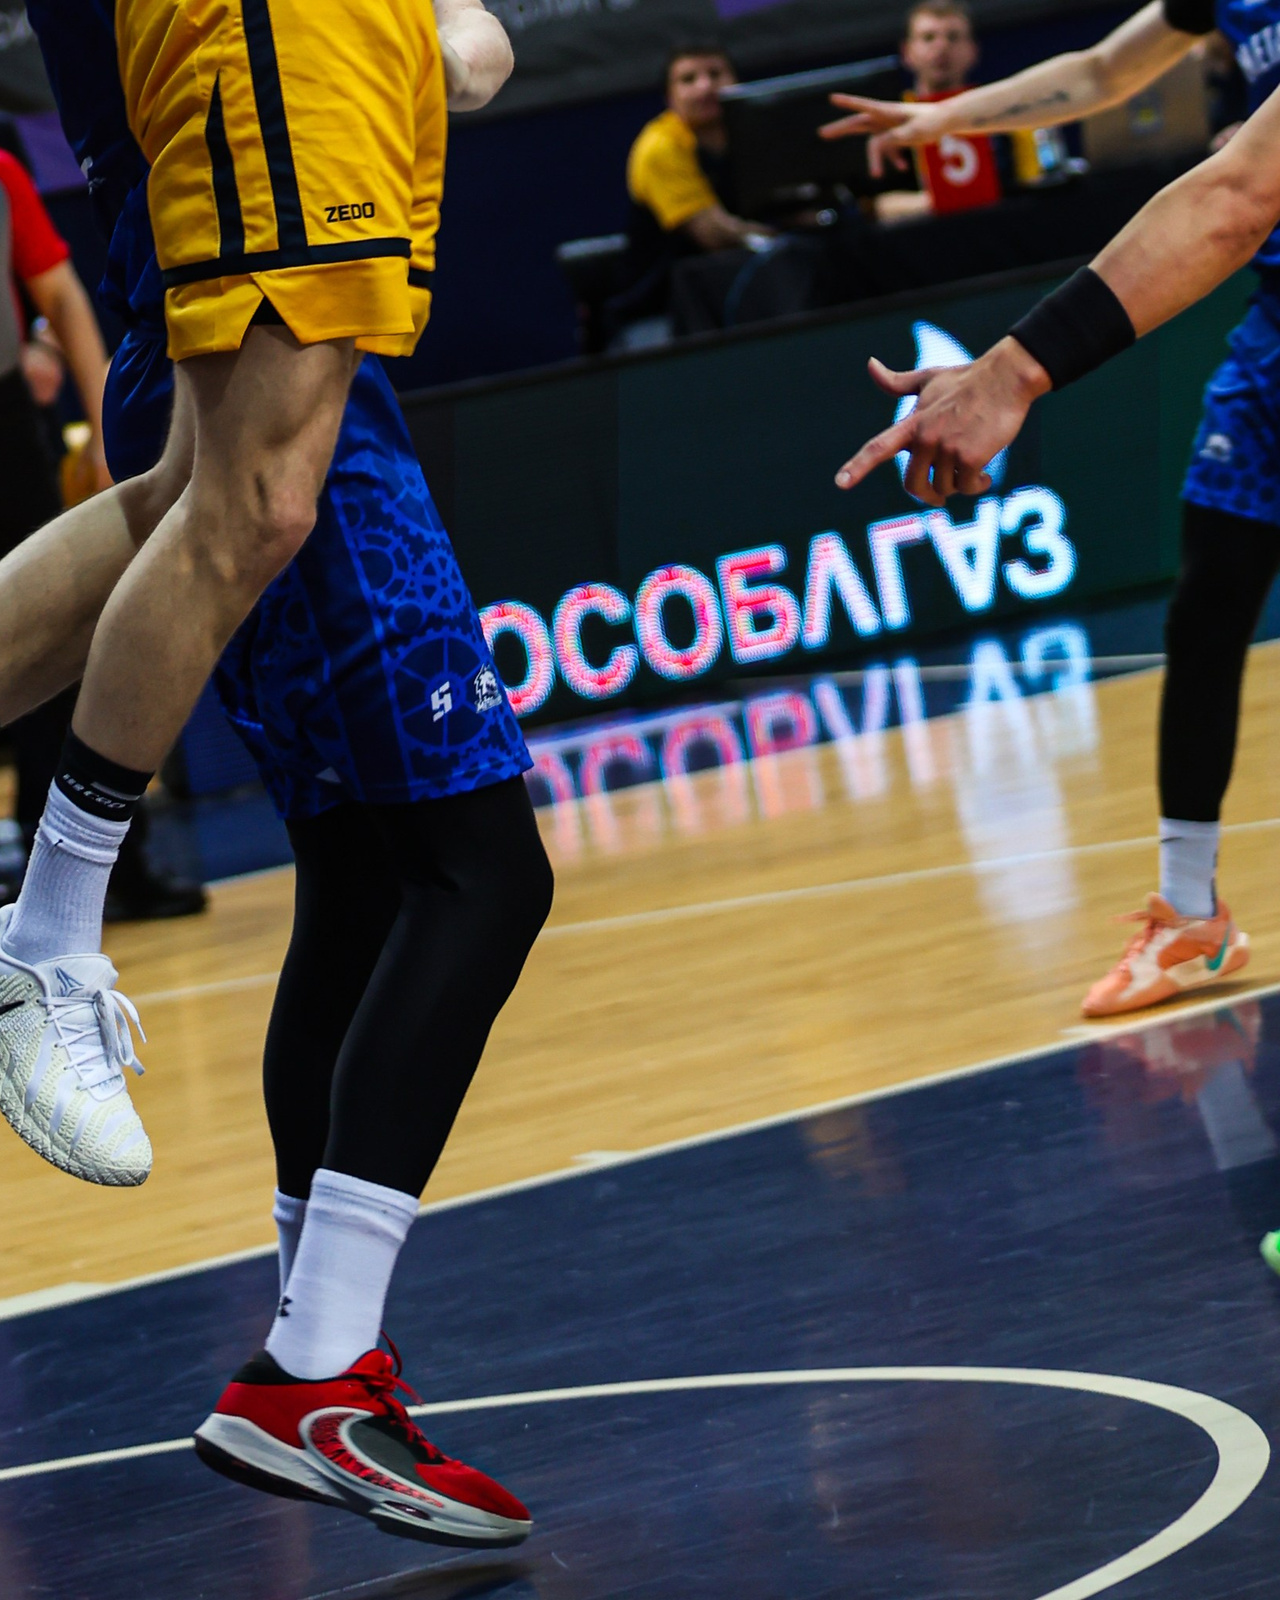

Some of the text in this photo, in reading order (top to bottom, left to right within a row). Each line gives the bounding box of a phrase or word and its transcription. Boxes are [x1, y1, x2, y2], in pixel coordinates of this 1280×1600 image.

[939, 134, 979, 188] 5
[324, 201, 376, 224] ZEDO
[477, 484, 1078, 720] ОСОБЛГАЗ
